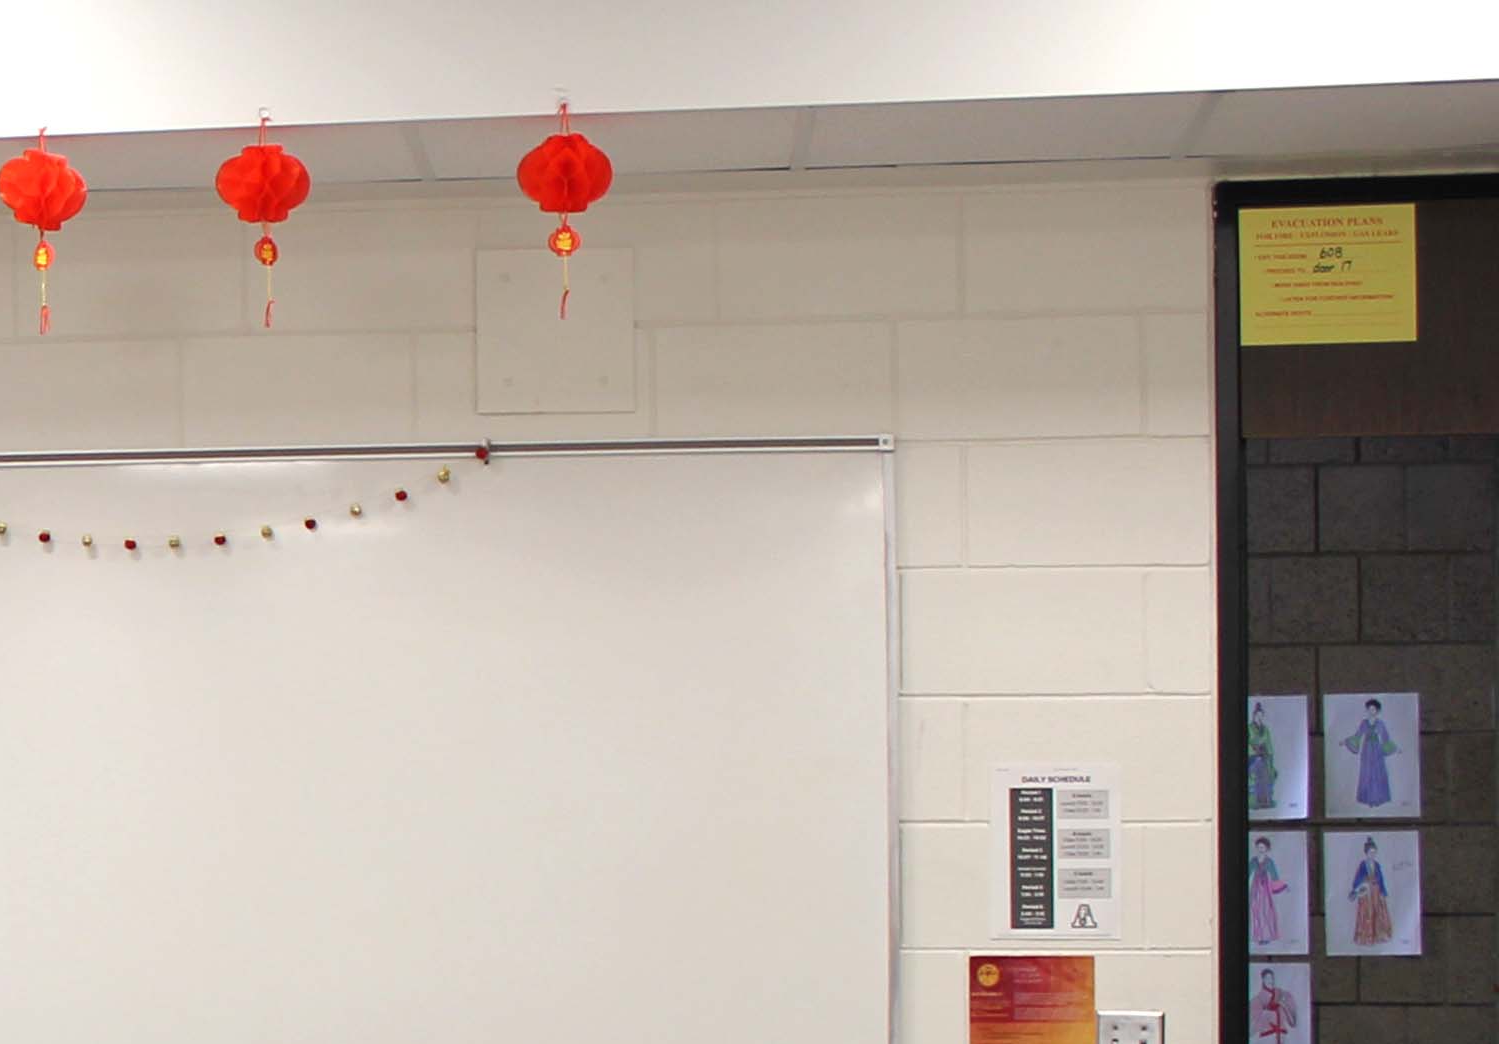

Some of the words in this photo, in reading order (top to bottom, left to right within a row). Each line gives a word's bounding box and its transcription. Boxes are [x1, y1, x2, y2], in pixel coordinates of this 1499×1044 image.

[1271, 218, 1344, 229] EVACUATION
[1347, 217, 1384, 226] PLANS
[1021, 775, 1046, 783] DAILY
[1048, 775, 1091, 783] SCHEDULE
